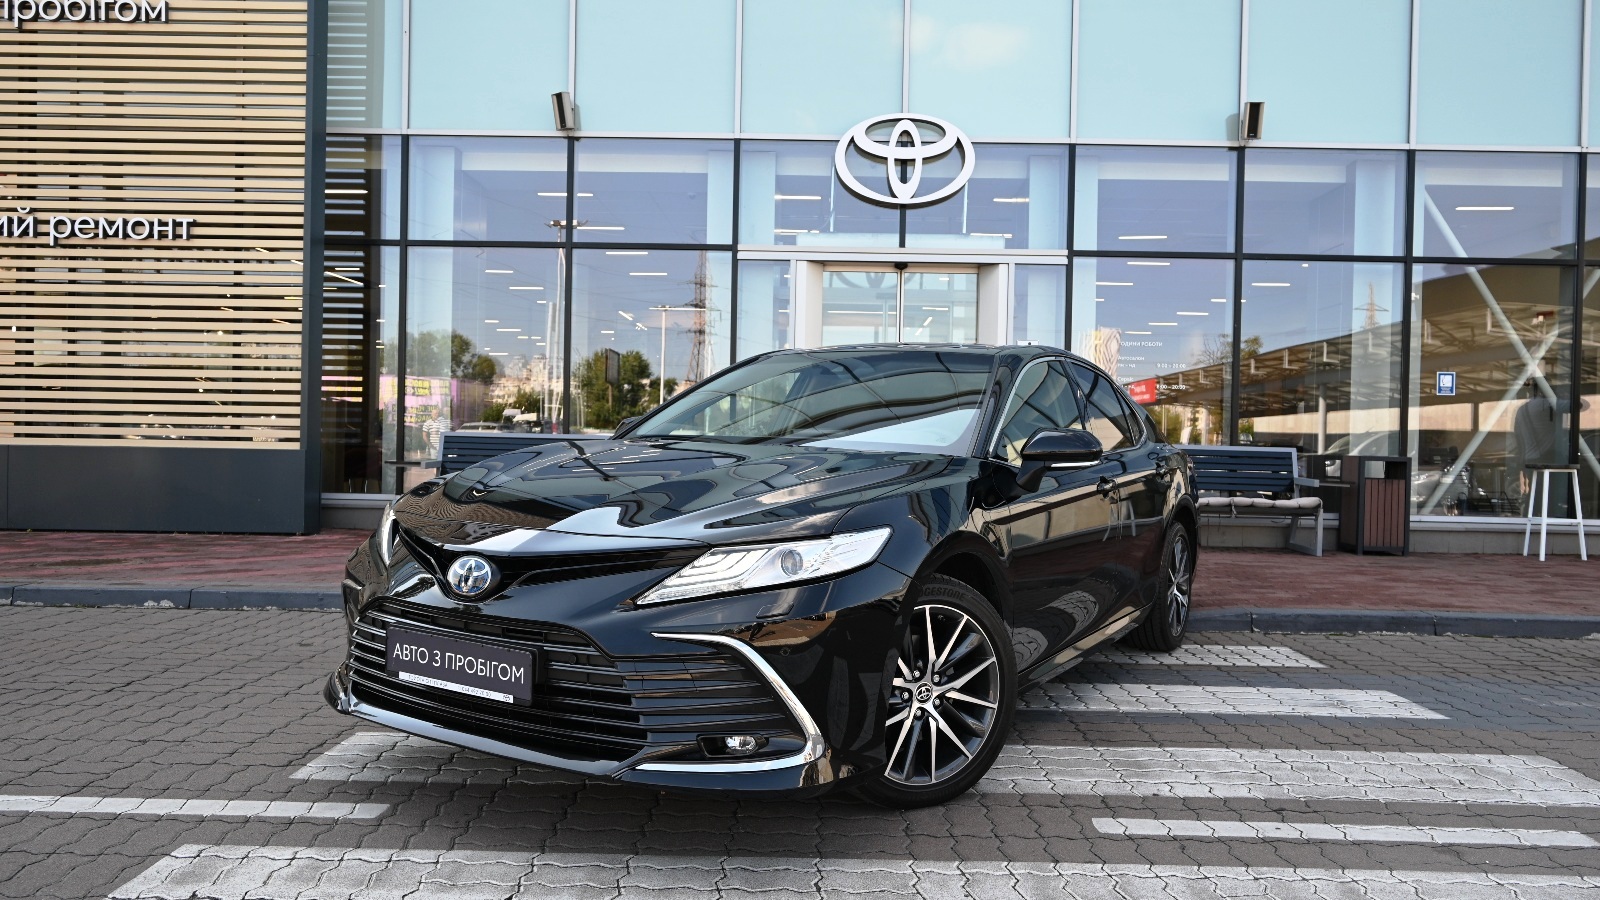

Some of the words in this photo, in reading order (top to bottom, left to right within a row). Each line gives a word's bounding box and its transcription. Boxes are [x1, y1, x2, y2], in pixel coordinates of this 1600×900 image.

[50, 215, 195, 246] ремонт
[393, 642, 429, 664] АВТО
[432, 650, 441, 667] З
[445, 652, 524, 685] ПРОБІГОМ
